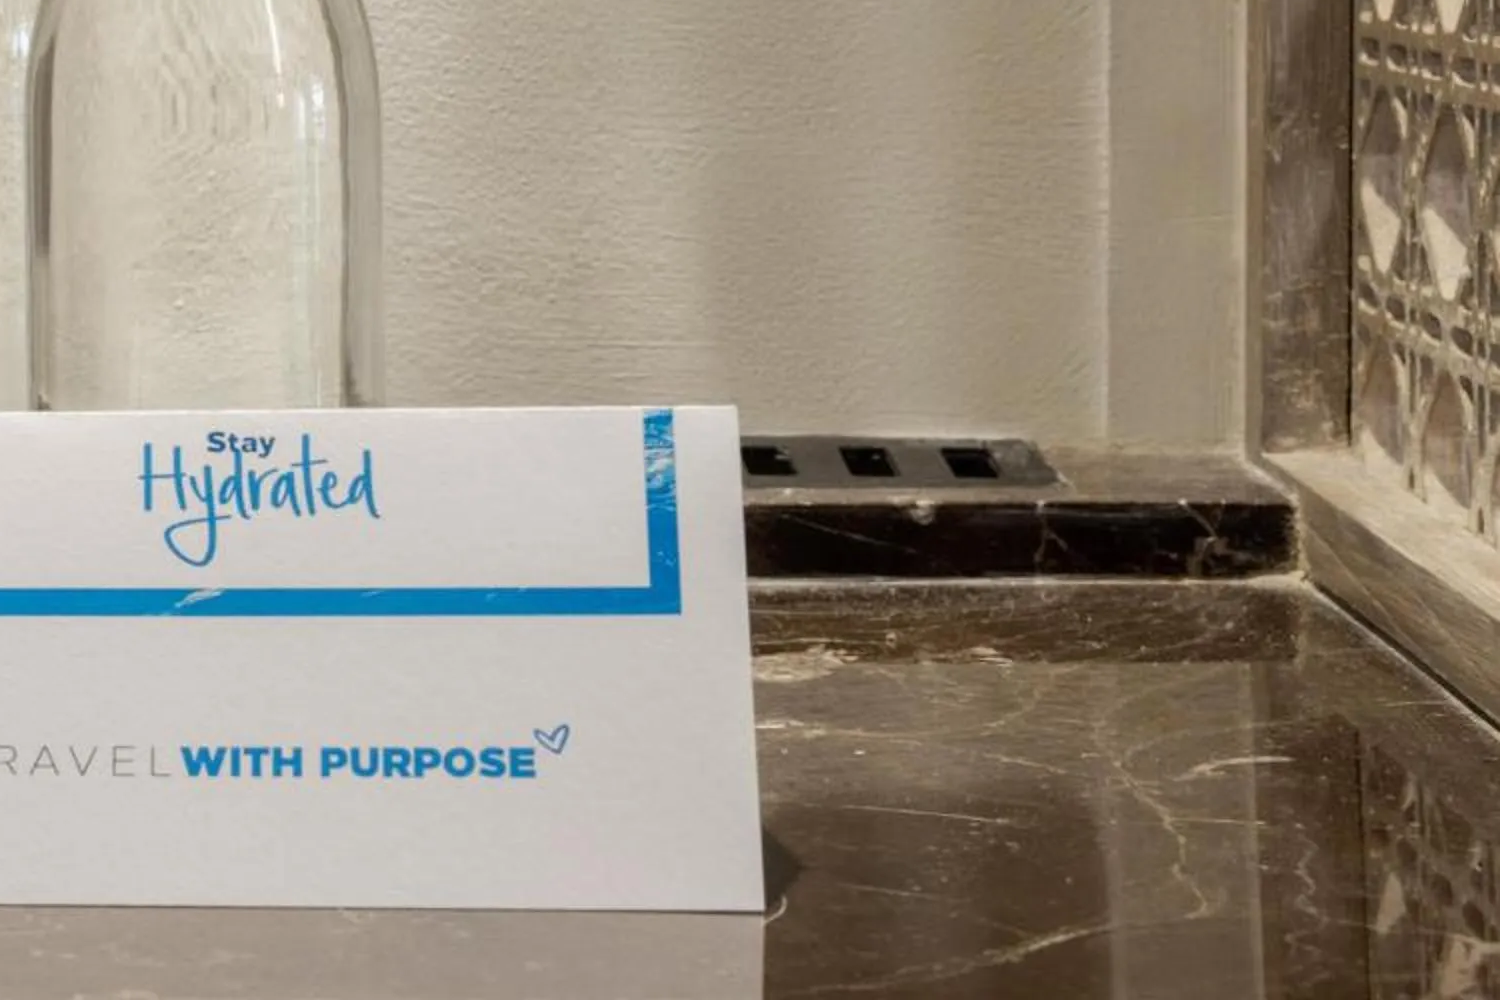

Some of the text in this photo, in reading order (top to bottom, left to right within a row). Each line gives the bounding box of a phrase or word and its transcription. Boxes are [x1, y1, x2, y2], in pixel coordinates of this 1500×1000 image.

[206, 431, 276, 458] Stay
[138, 433, 381, 567] Hydrated
[180, 745, 304, 778] WITH
[320, 746, 537, 779] PURPOSE
